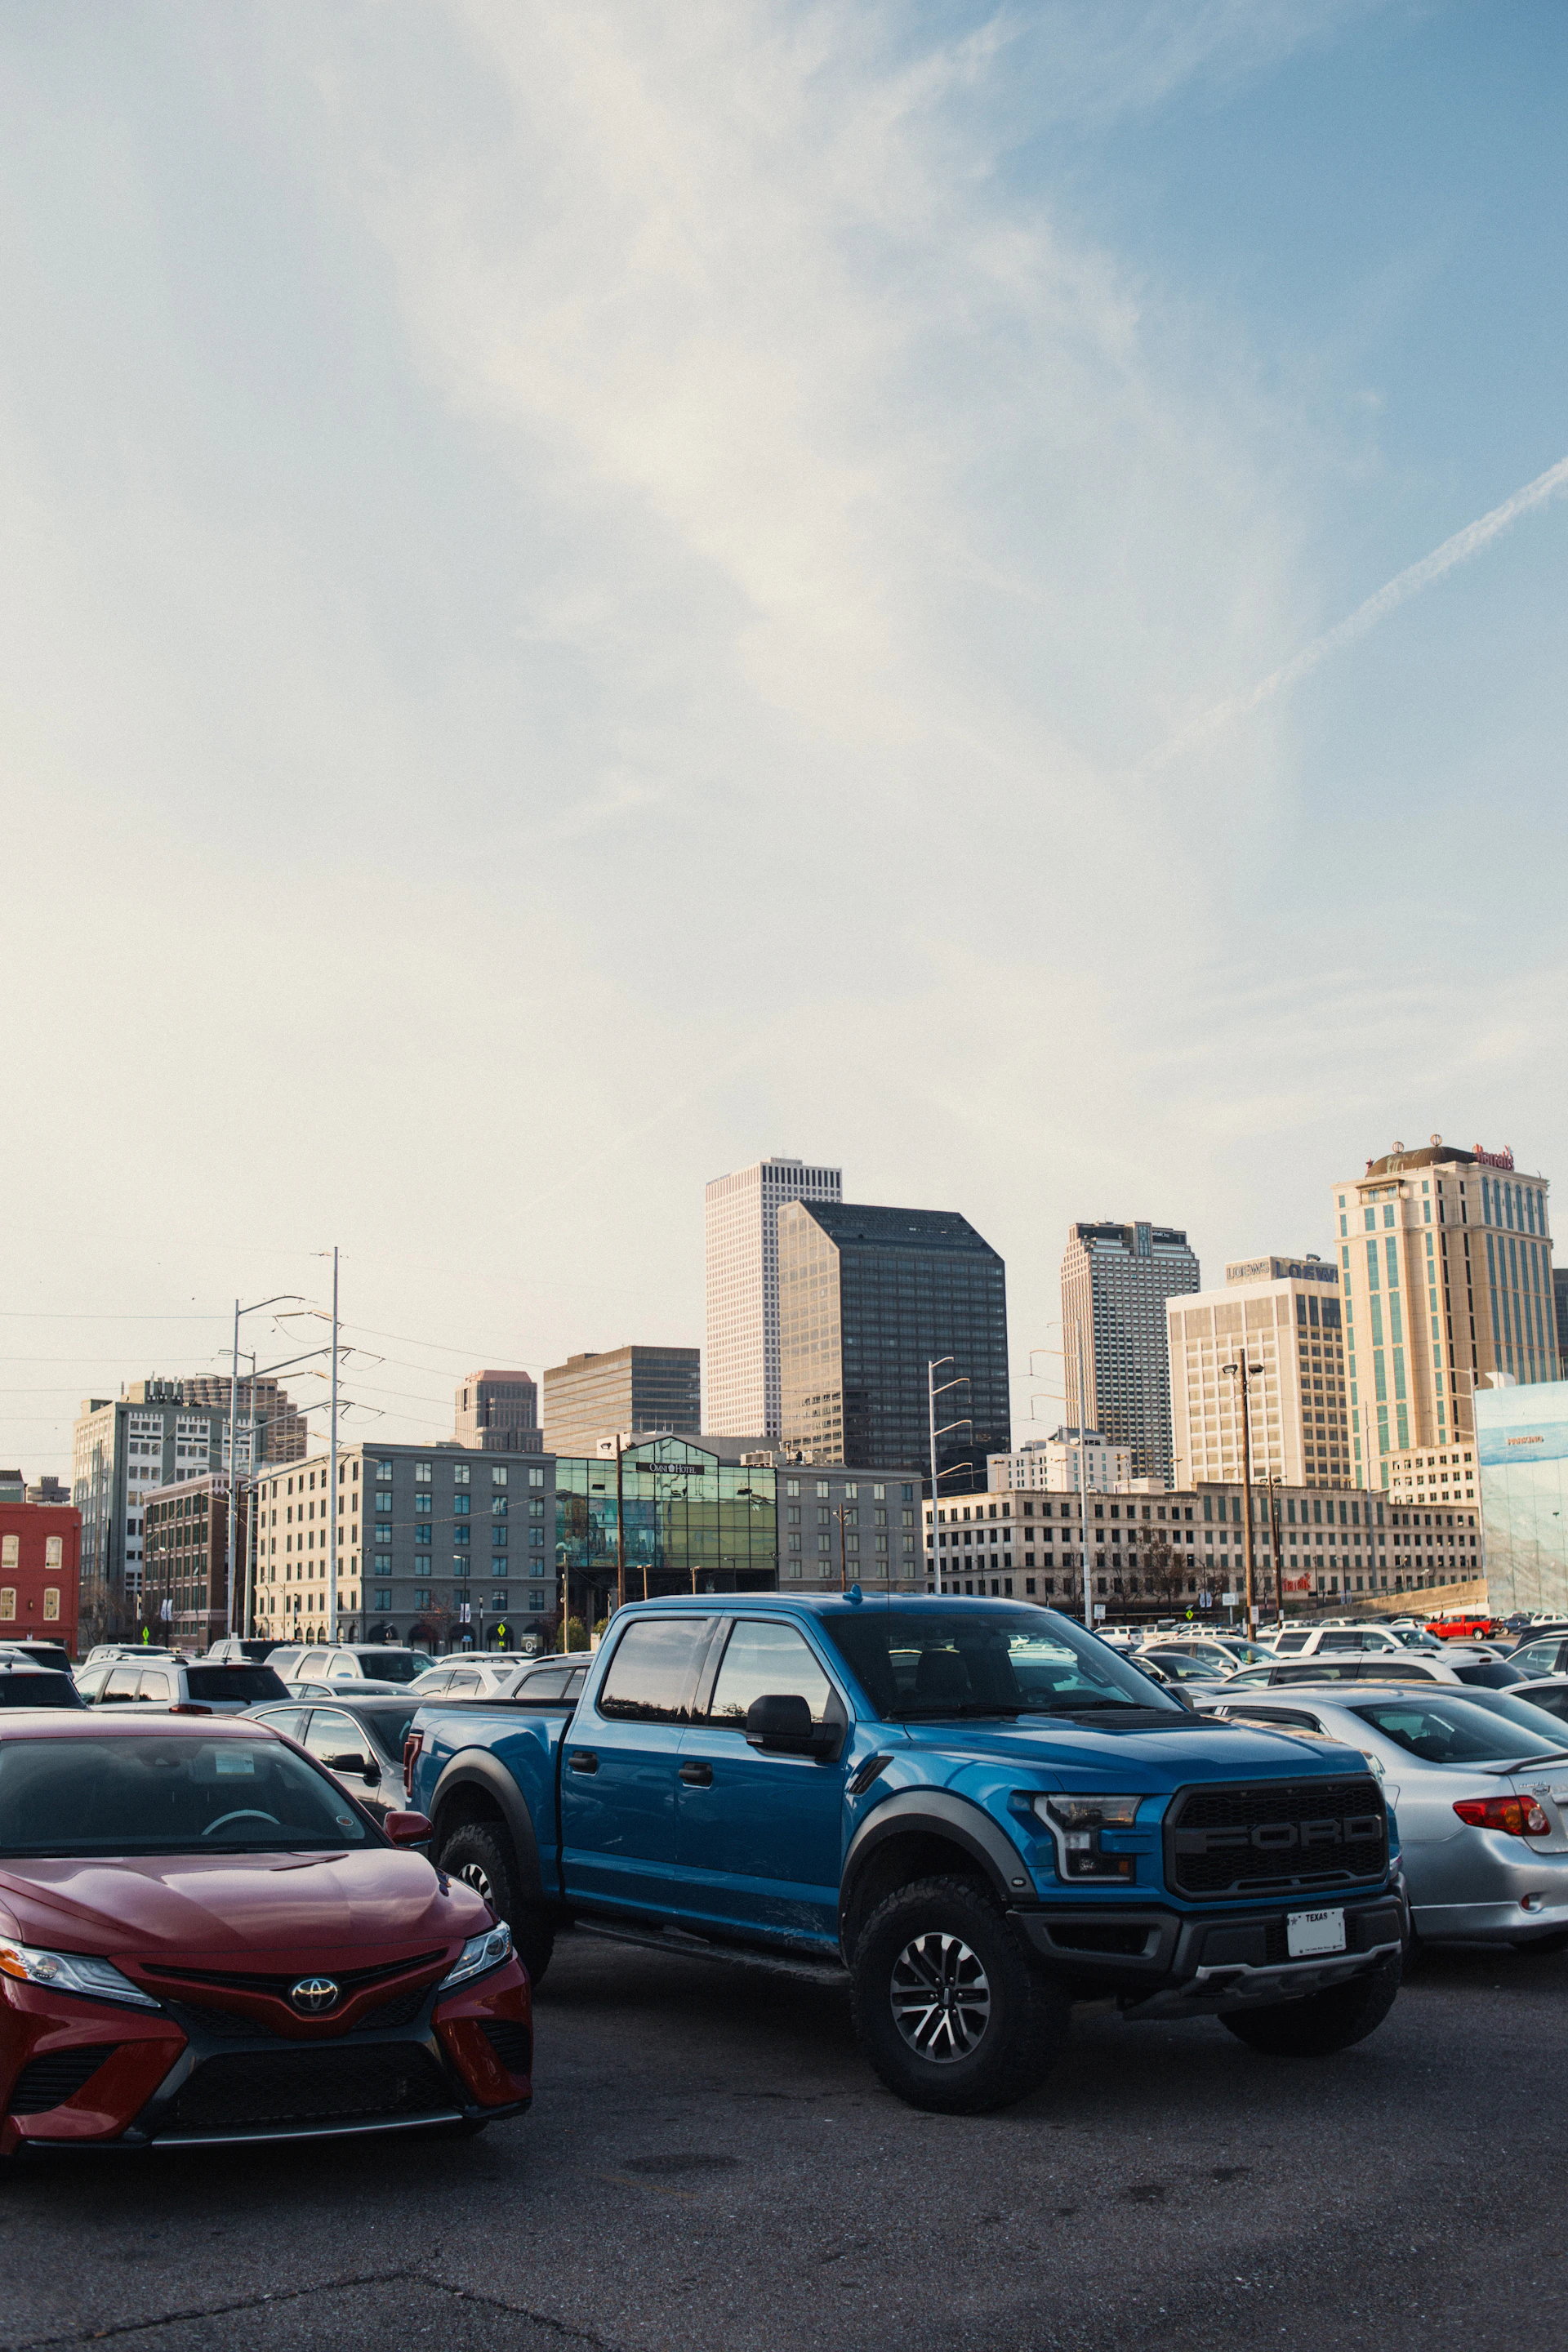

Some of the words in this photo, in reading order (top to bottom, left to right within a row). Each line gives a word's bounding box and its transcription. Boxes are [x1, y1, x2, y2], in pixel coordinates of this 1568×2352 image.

[1227, 1262, 1269, 1280] LOEWS
[1507, 1436, 1544, 1446] PARKING
[675, 1464, 697, 1474] HOTEL
[1175, 1815, 1382, 1854] FORD
[1305, 1912, 1328, 1922] TEXAS
